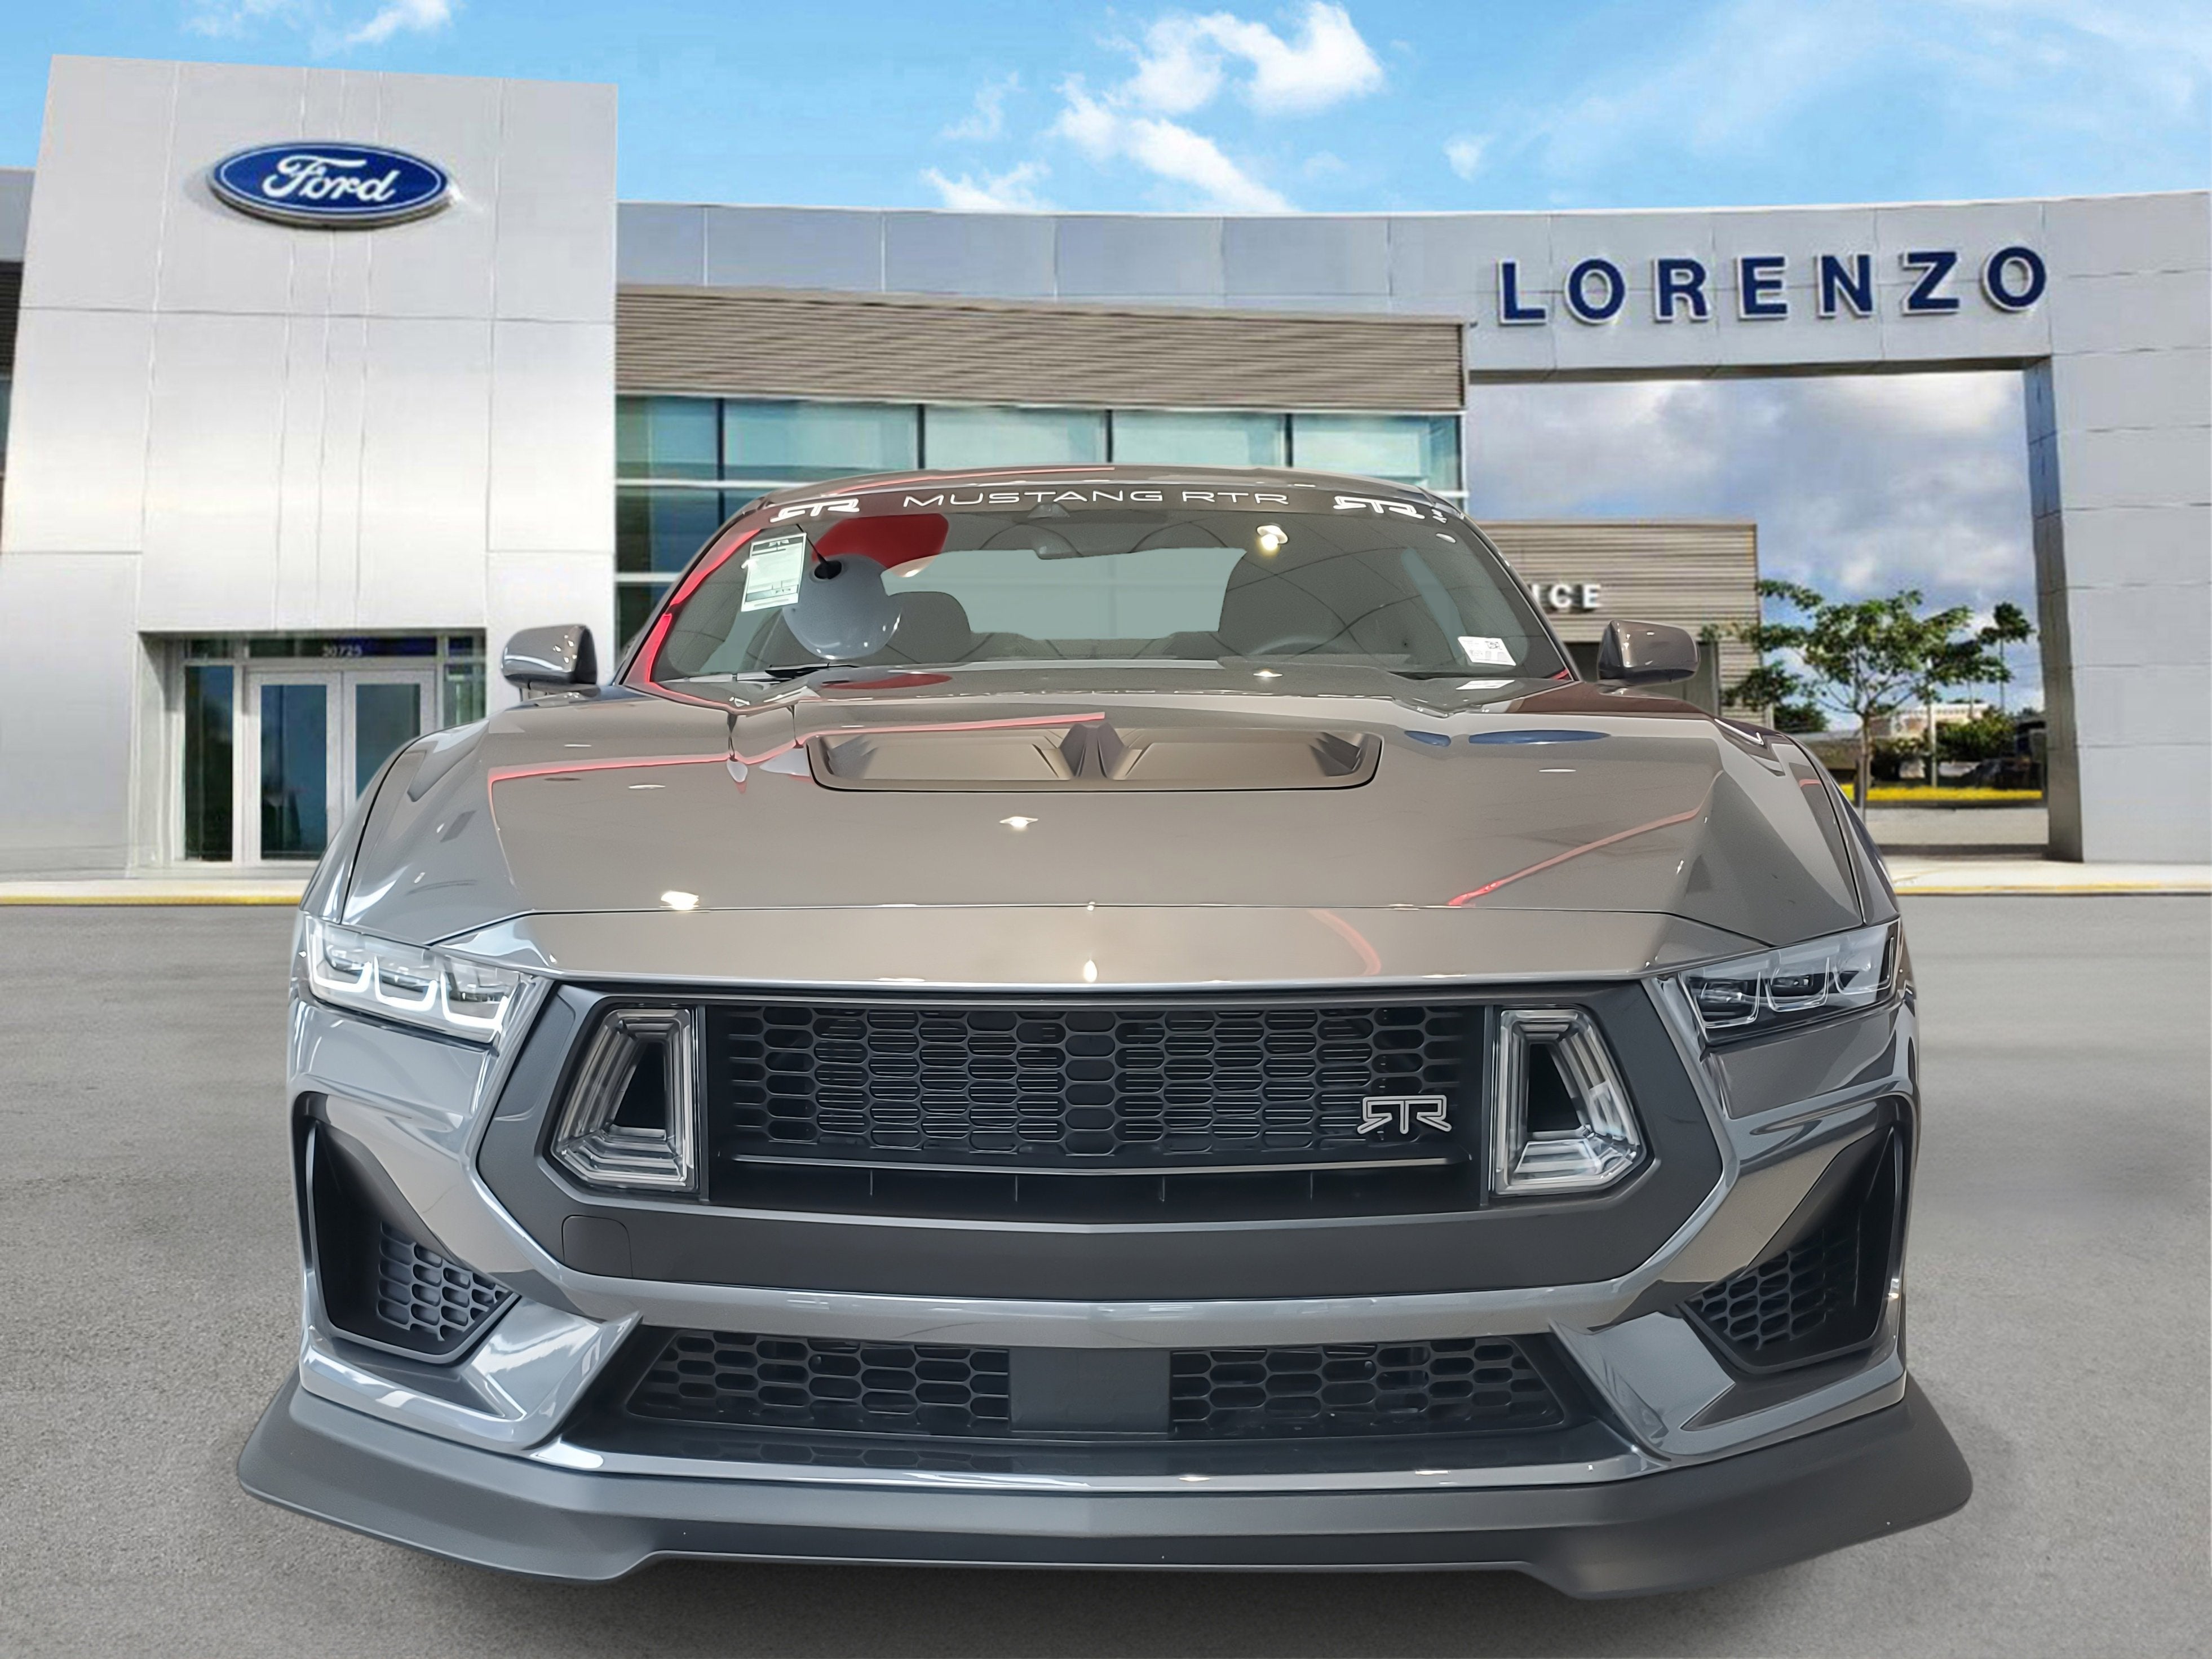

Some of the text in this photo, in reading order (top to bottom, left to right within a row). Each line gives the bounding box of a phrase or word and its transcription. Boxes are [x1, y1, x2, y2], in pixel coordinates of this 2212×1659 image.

[262, 154, 400, 201] Ford
[1498, 246, 2047, 326] LORENZO
[903, 490, 1289, 507] MUSTANG RTR
[1357, 1095, 1452, 1134] RTR
